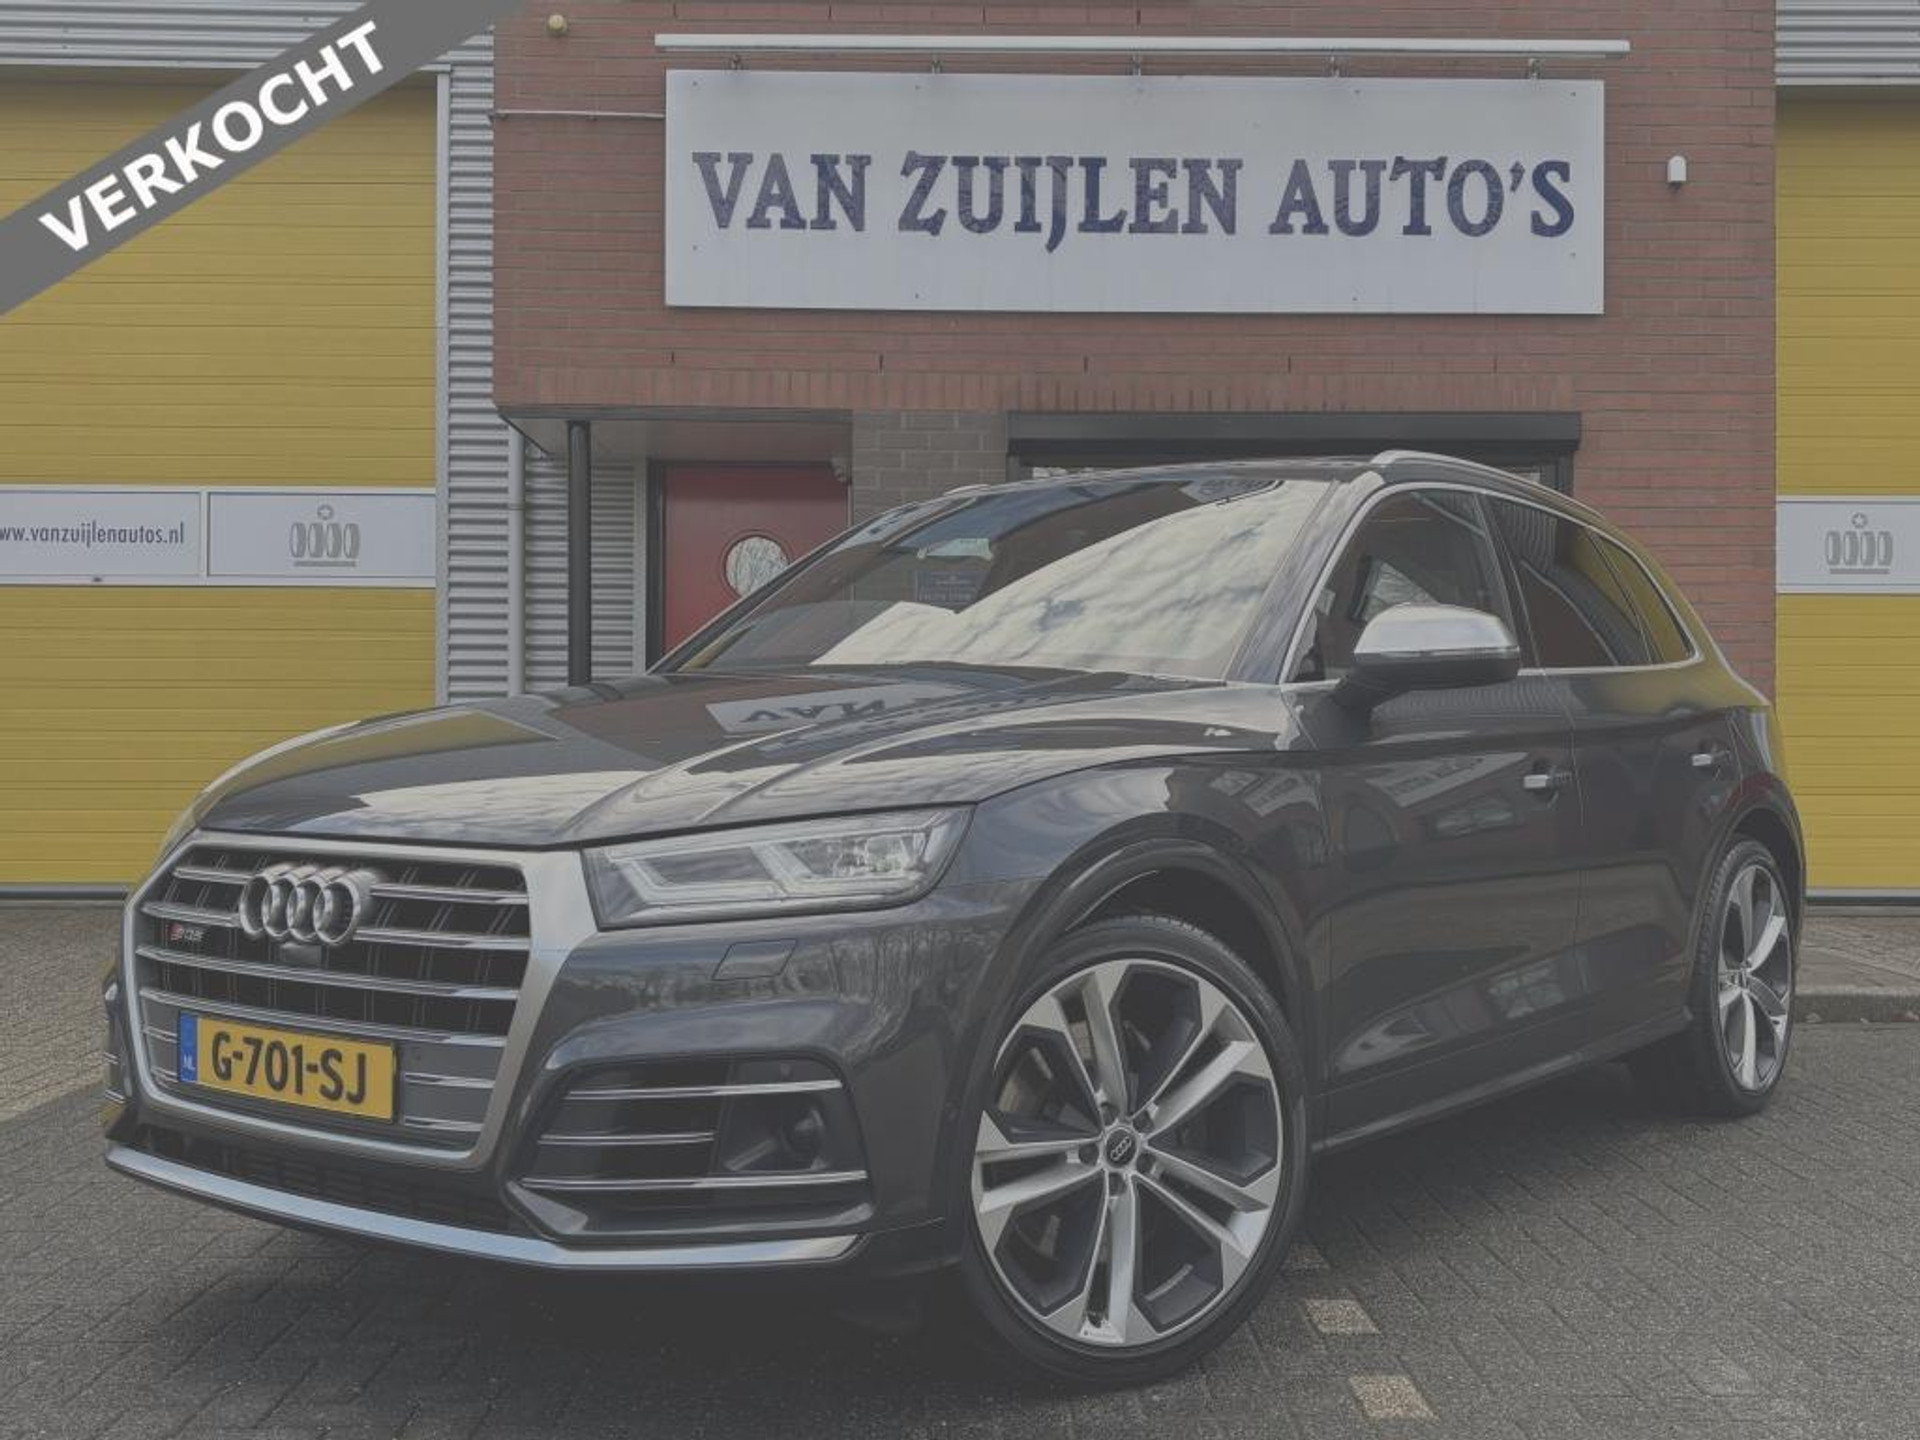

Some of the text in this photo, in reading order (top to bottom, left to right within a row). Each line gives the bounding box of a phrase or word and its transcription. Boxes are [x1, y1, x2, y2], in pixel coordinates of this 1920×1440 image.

[692, 150, 1575, 253] VAN ZUIJLEN AUTO'S
[211, 1031, 367, 1104] G-701-SJ
